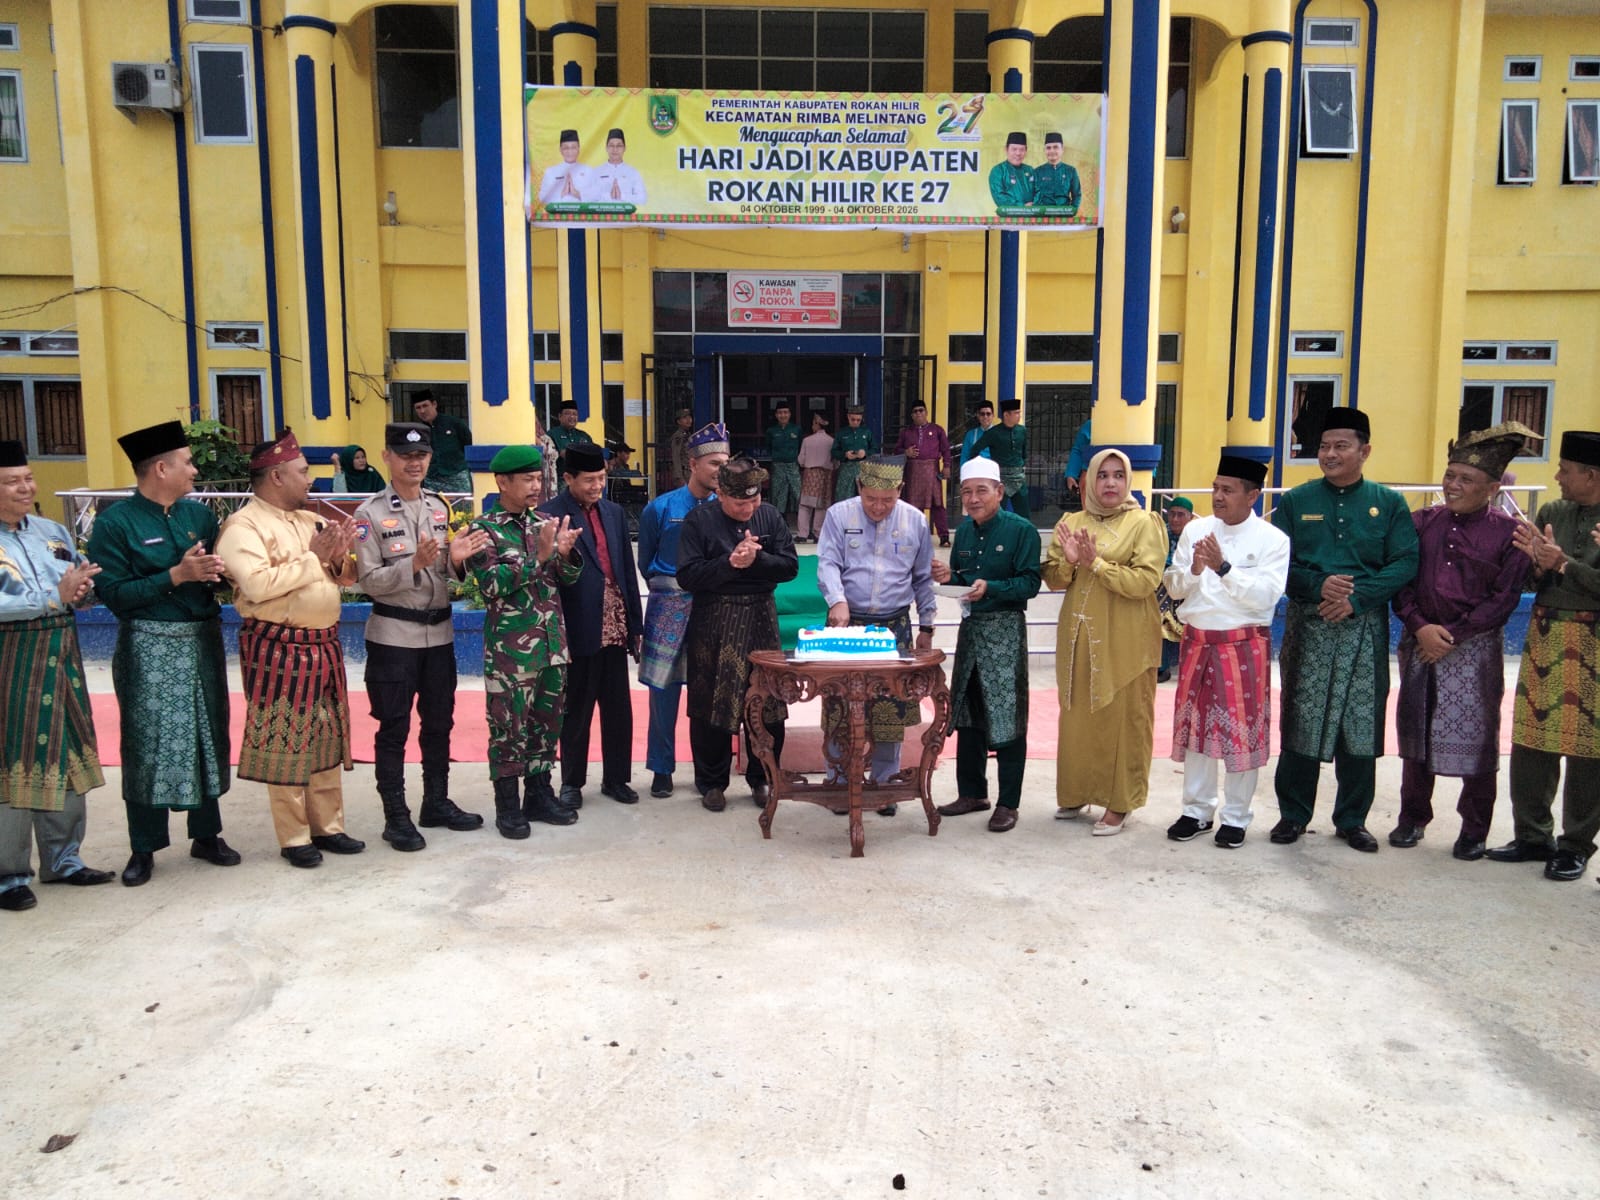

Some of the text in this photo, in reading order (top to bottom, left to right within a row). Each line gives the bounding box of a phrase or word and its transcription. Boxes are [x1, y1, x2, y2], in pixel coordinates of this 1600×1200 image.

[711, 99, 920, 110] PEMERINTAH KABUPATEN ROKAN HILIR
[705, 111, 927, 124] KECAMATAN RIMBA MELINTANG
[740, 126, 907, 147] Mengucapkan Selamat
[679, 148, 978, 172] HARI JADI KABUPATEN
[708, 180, 950, 203] ROKAN HILIR KE 27
[740, 204, 751, 213] 04
[753, 204, 801, 214] OKTOBER
[804, 205, 826, 214] 1999
[833, 205, 844, 214] 04
[846, 205, 895, 214] OKTOBER
[896, 205, 919, 214] 2026
[759, 279, 797, 287] KAWASAN
[760, 287, 793, 296] TANPA
[759, 296, 796, 305] ROKOK
